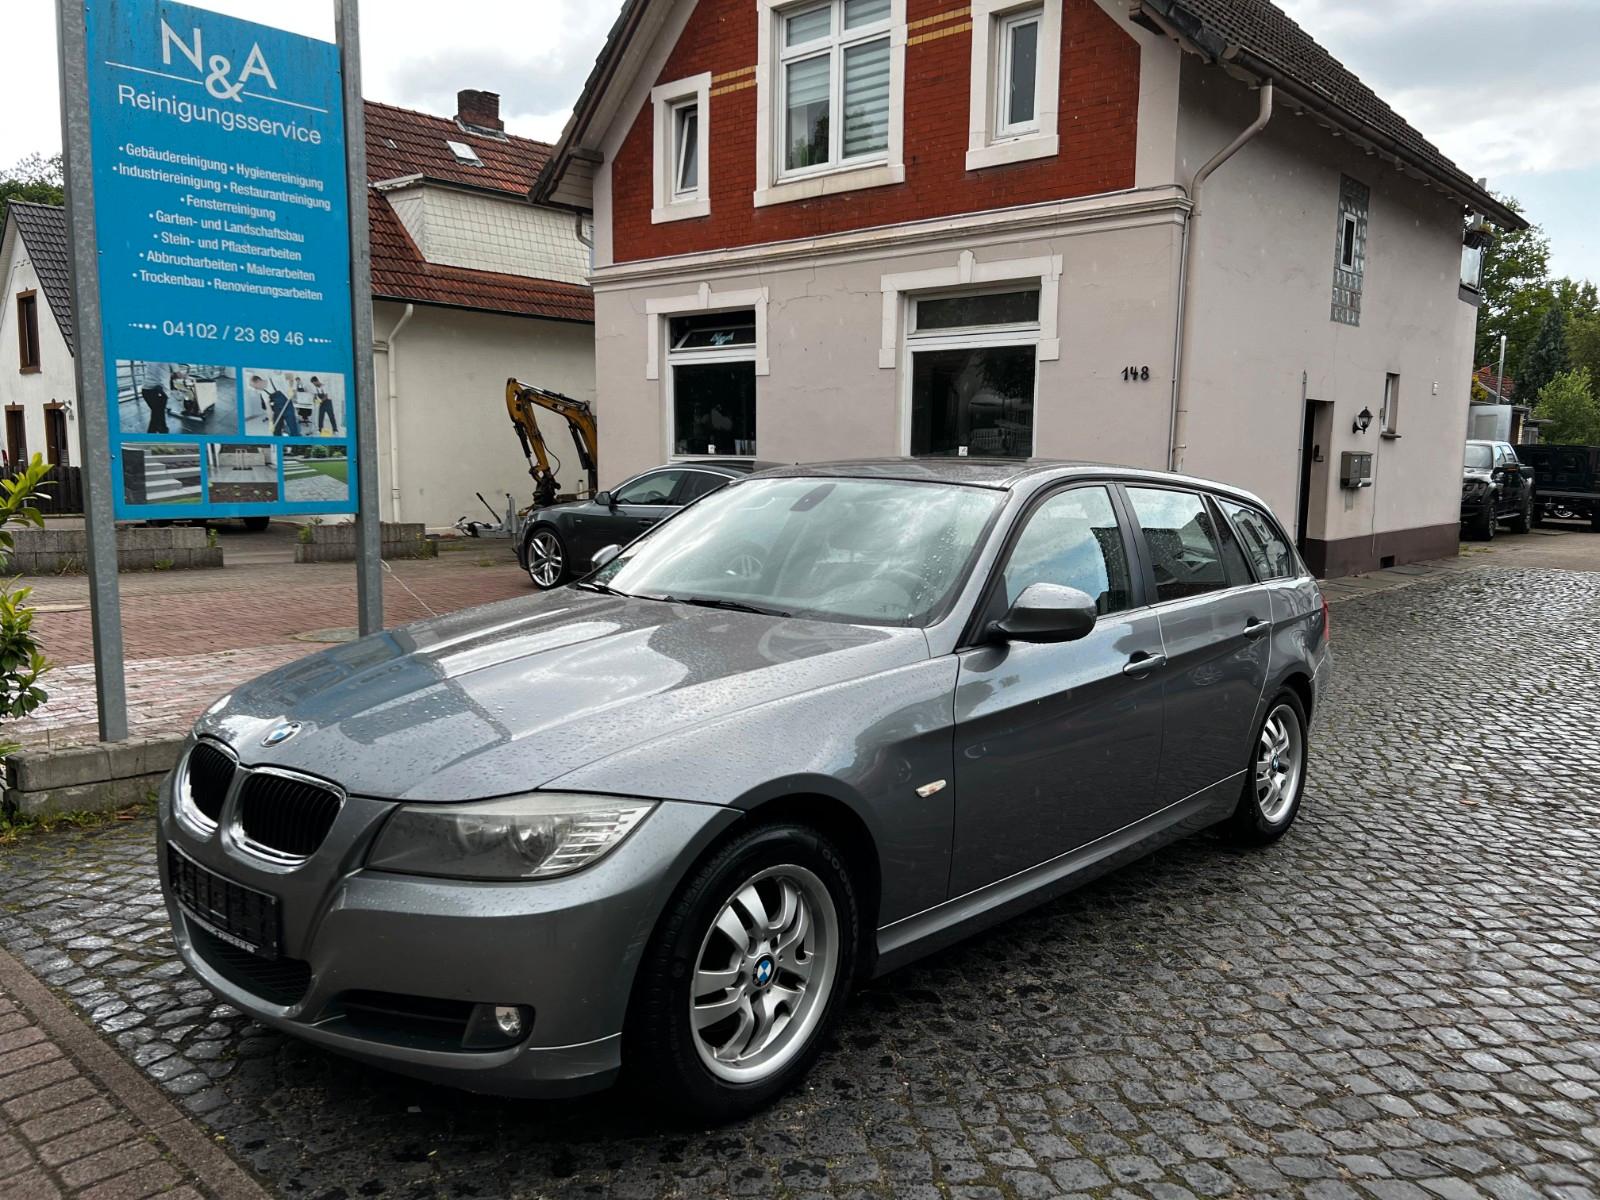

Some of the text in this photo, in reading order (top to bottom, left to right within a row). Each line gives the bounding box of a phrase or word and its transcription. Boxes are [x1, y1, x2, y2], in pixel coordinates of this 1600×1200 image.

[160, 18, 278, 103] N&A
[118, 84, 321, 145] Reinigungsservice
[126, 143, 324, 192] Gebäudereinigung Hygienereinigung
[119, 162, 331, 211] Industriereinigung Restaurantreinigung
[186, 194, 276, 222] Fensterreinigung
[155, 210, 305, 243] Garten- und Landschaftsbau
[161, 231, 302, 261] Stein- und Pflasterarbeiten
[147, 250, 316, 282] Abbrucharbeiten Malerarbeiten
[139, 269, 323, 301] Trockenbau Renovierungsarbeiten
[162, 320, 218, 339] 04102
[234, 327, 255, 342] 23
[259, 329, 280, 344] 89
[284, 331, 304, 346] 46
[1121, 365, 1150, 381] 148
